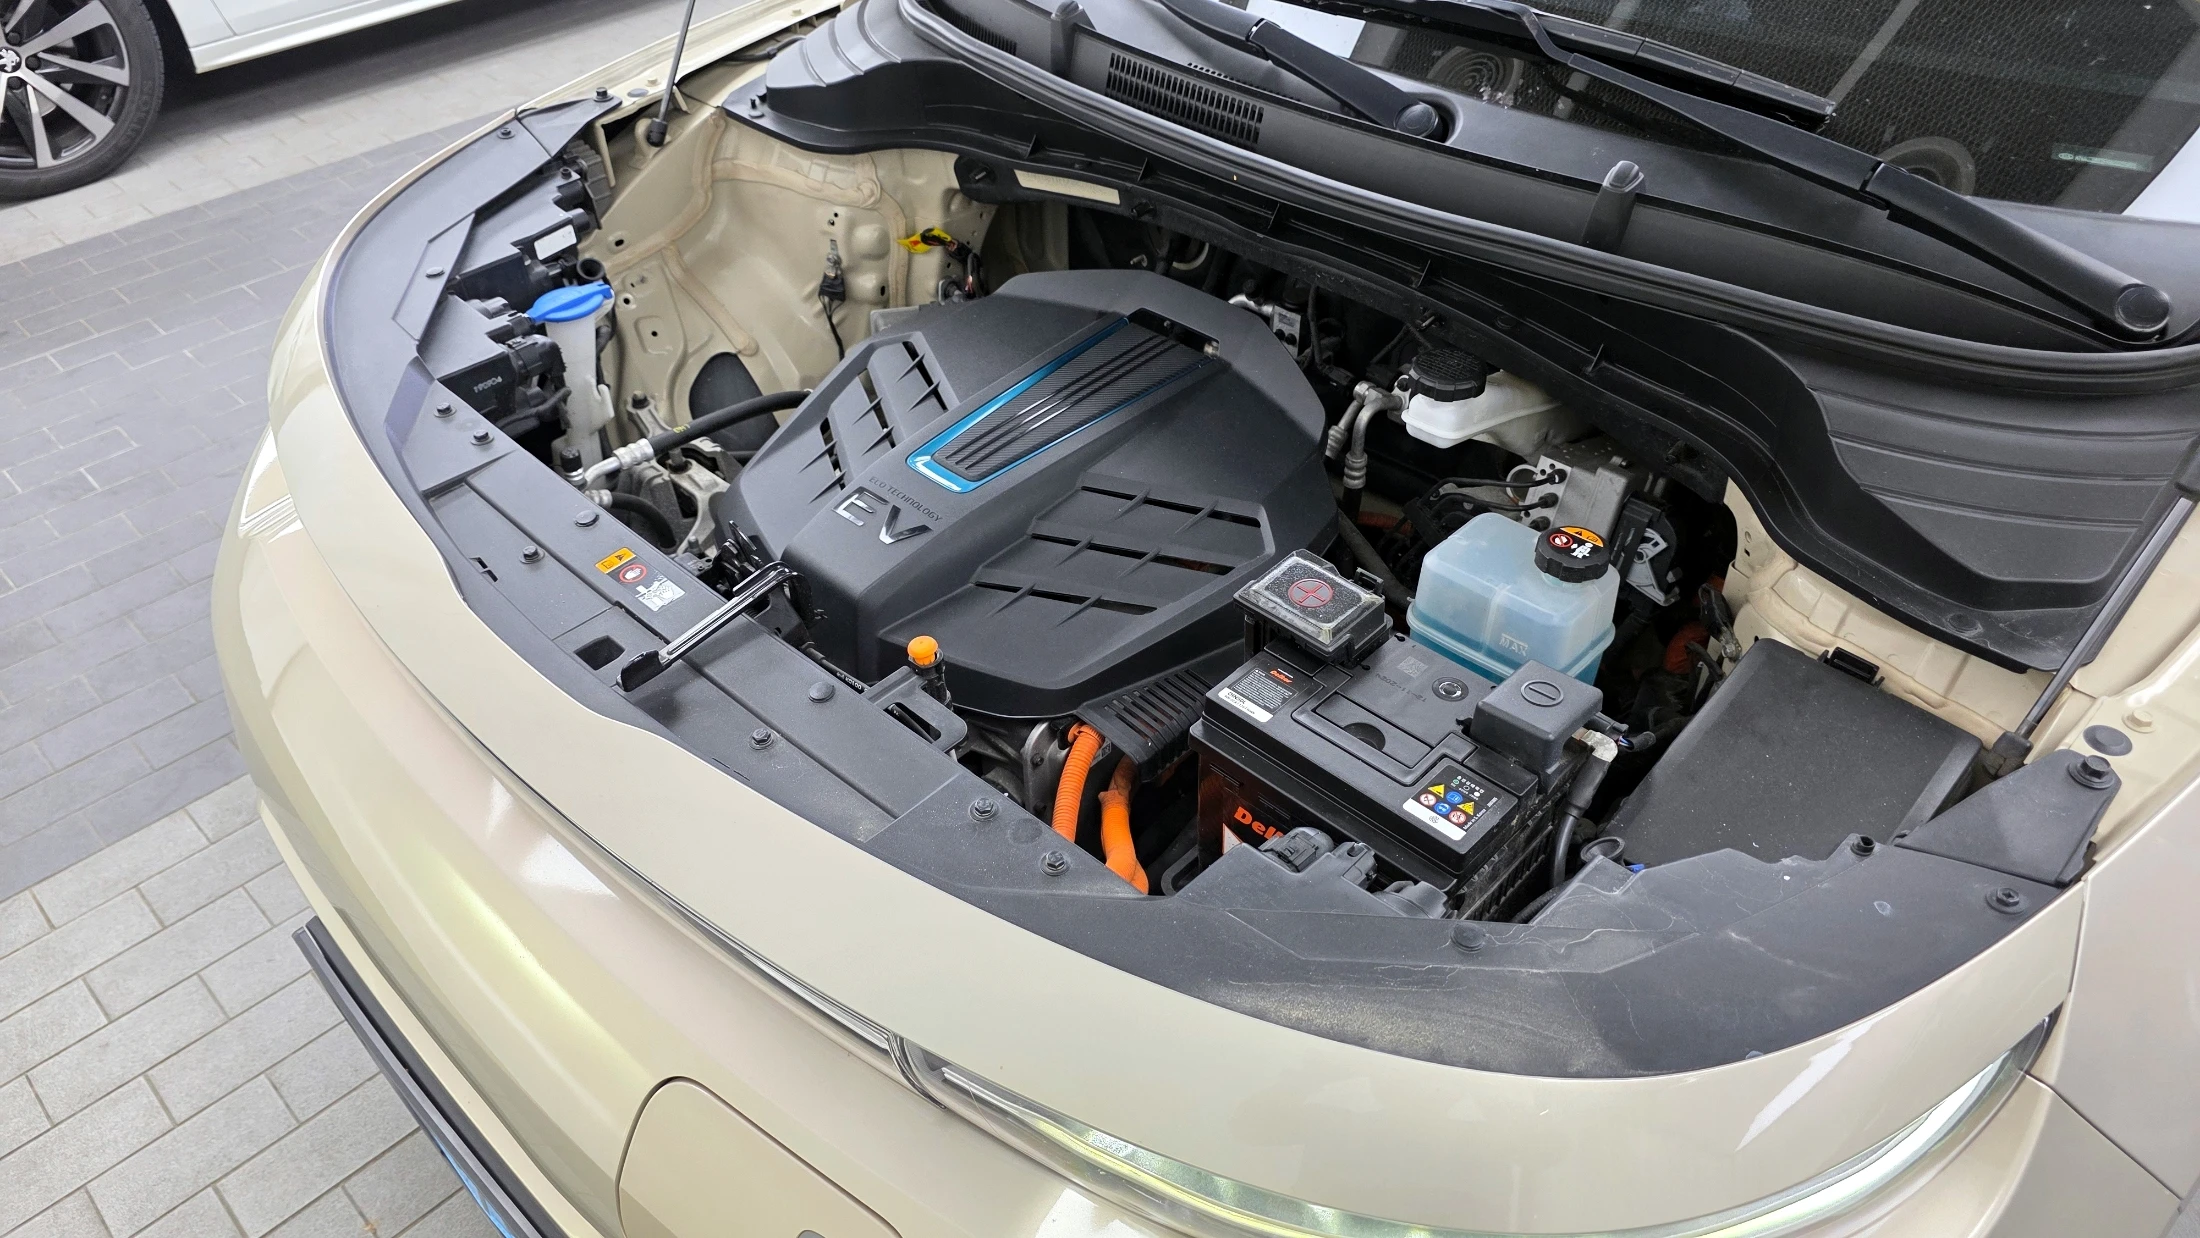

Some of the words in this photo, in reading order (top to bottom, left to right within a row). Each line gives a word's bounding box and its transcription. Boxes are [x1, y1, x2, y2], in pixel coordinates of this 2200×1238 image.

[832, 486, 934, 545] EV
[869, 476, 886, 489] ECO
[887, 487, 943, 522] TECHNOLOGY
[1499, 637, 1528, 657] MAX
[1234, 806, 1284, 840] Del
